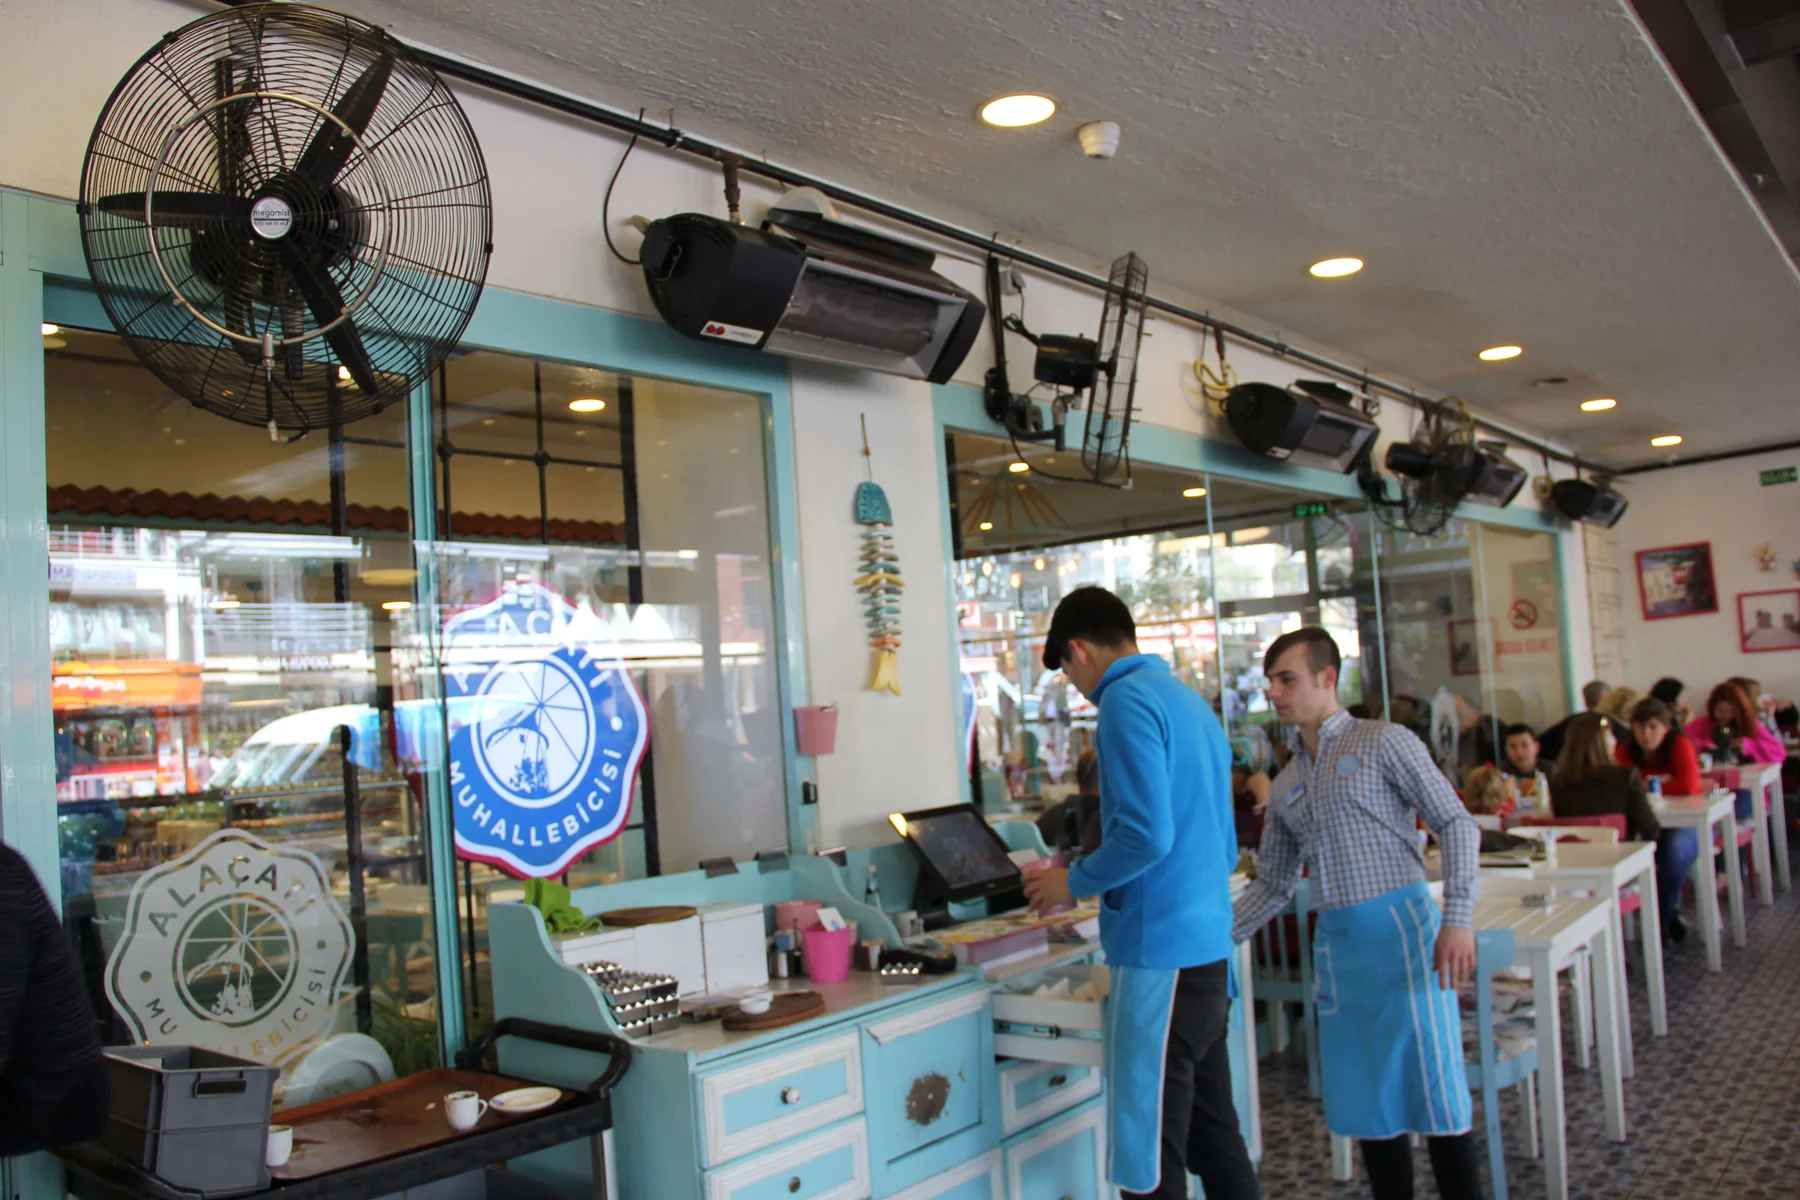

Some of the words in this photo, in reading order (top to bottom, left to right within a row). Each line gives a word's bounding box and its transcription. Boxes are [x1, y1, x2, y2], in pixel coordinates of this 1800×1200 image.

[450, 609, 612, 693] AAÇI
[149, 856, 316, 937] ALAÇATI
[146, 968, 326, 1057] MUEBİCİSİ
